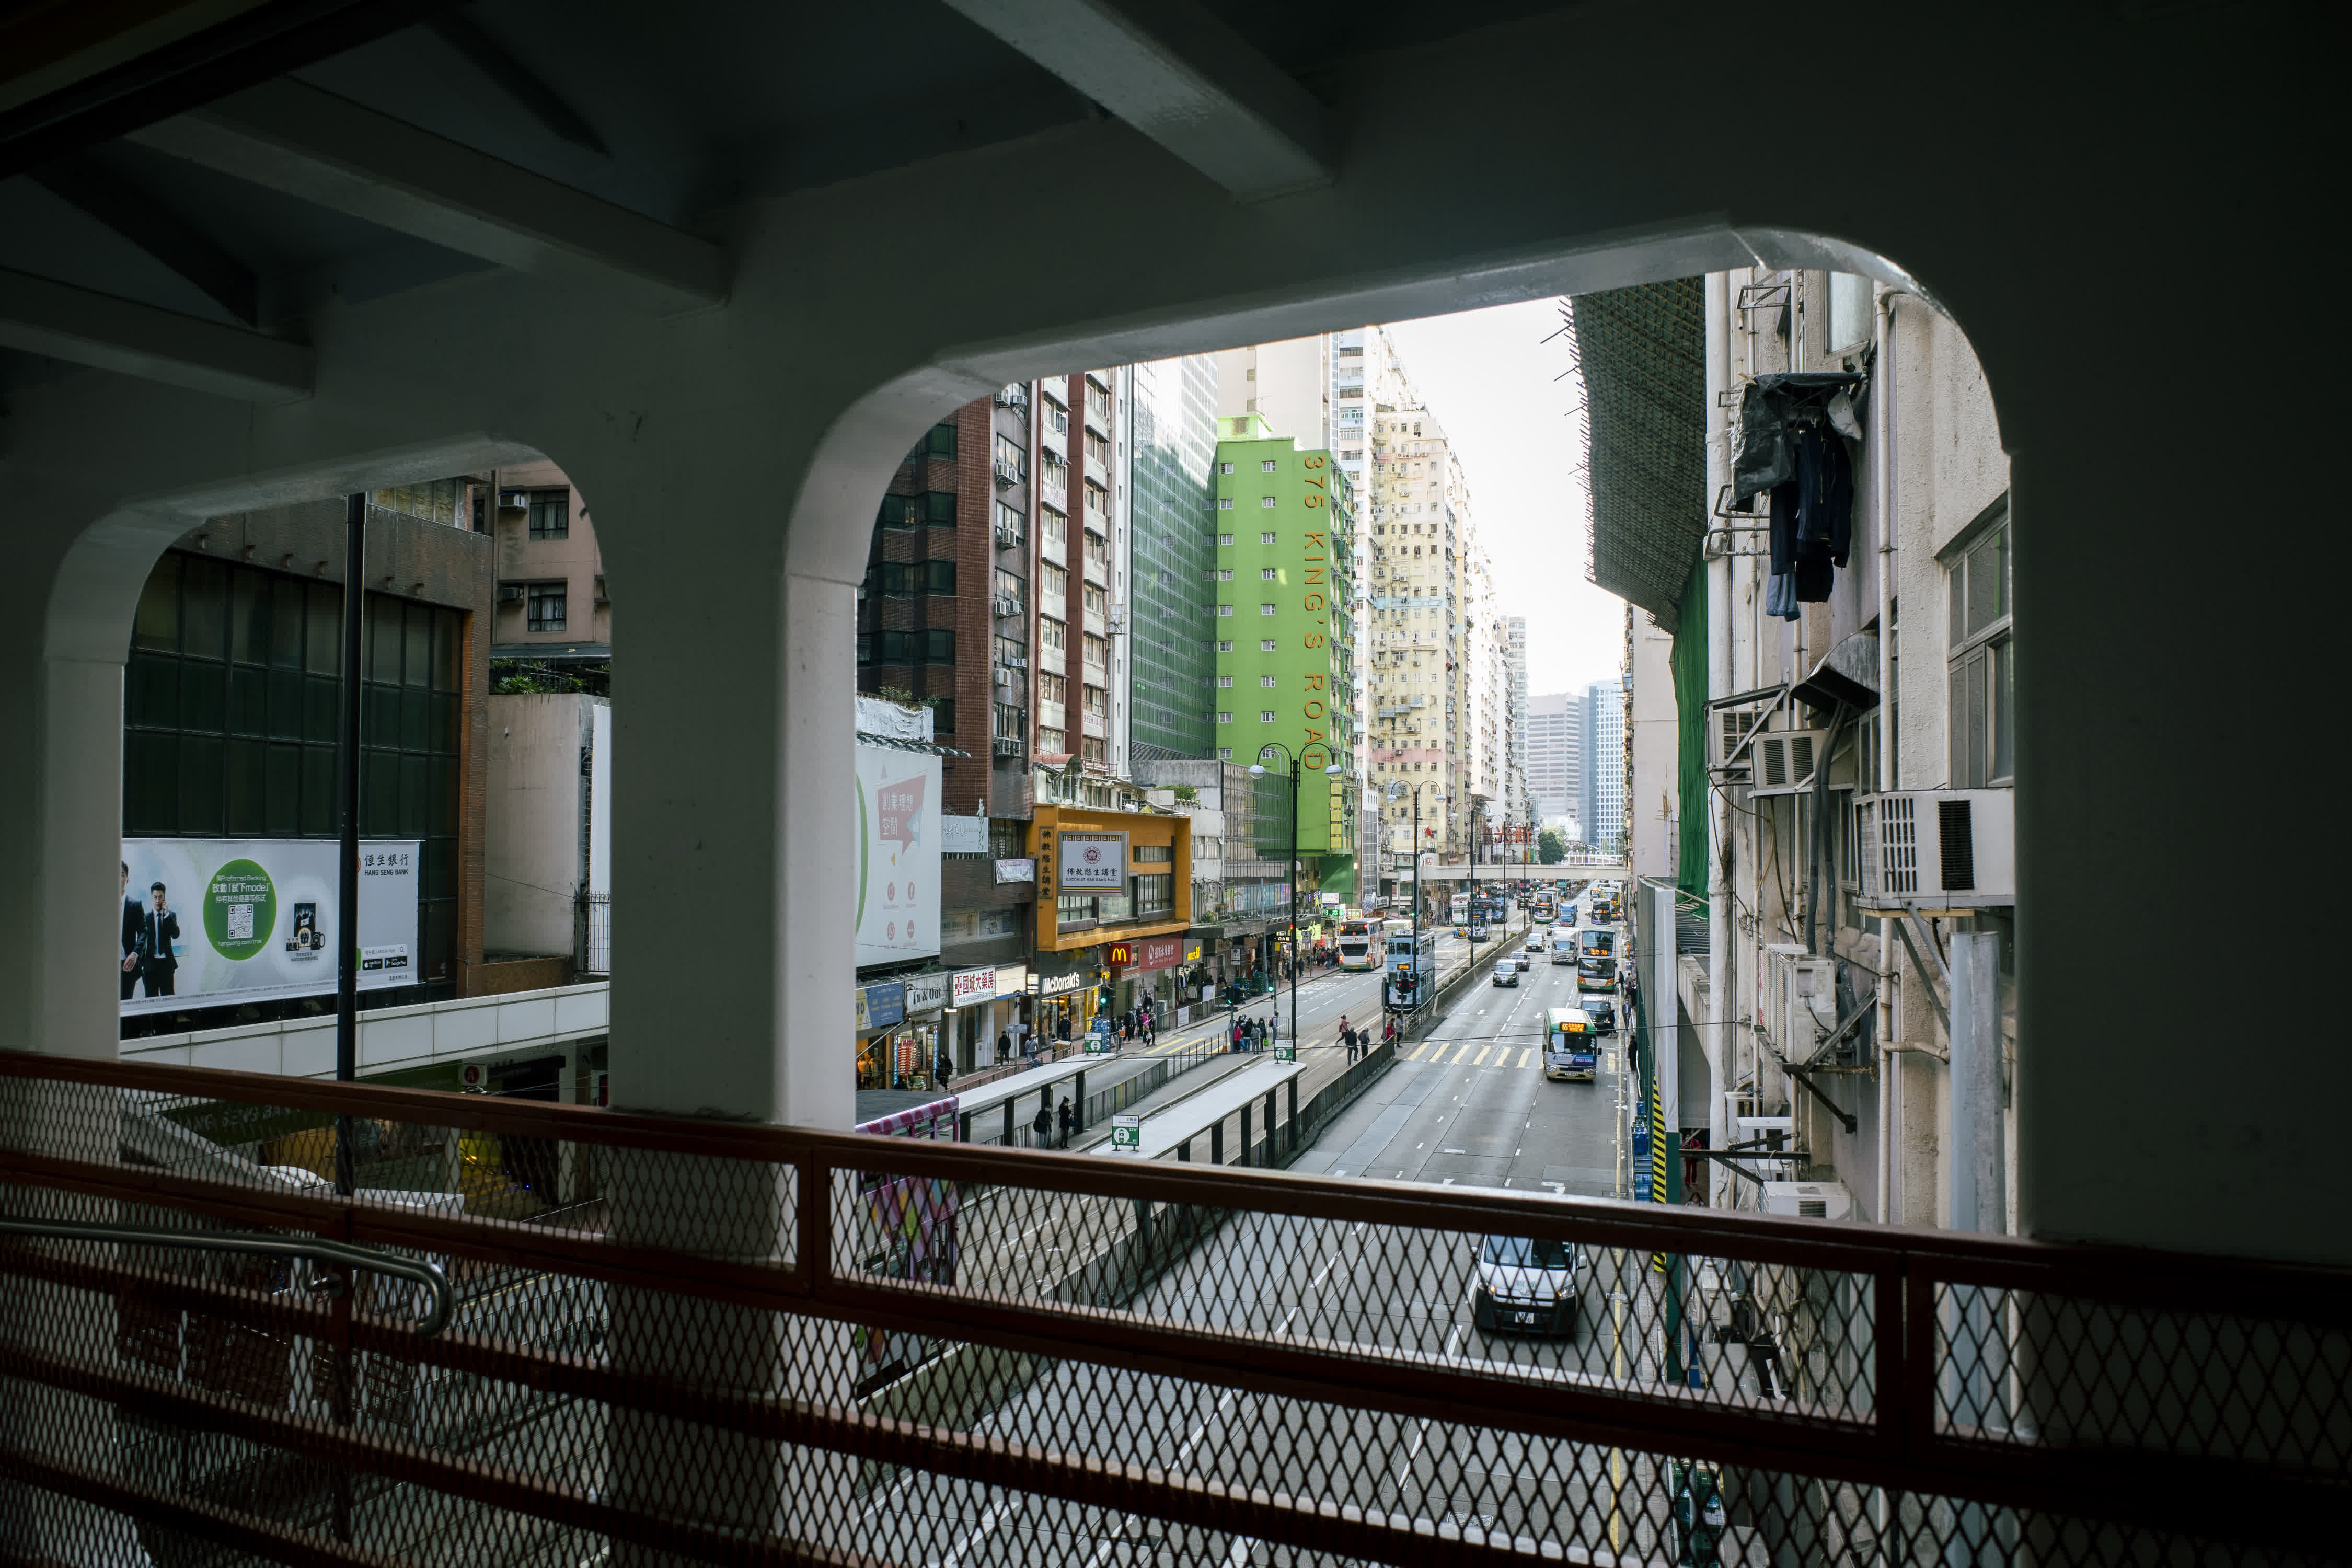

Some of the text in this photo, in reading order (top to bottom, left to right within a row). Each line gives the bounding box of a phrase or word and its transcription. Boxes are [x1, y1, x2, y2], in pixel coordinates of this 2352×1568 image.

[1304, 455, 1325, 771] 375 KING'S ROAD
[882, 816, 898, 836] 空間
[963, 970, 994, 994] 國城大藥房
[1042, 972, 1080, 995] McDonald's
[913, 991, 920, 1004] In
[922, 990, 928, 1002] &
[929, 987, 941, 1000] Out
[1562, 1023, 1569, 1031] 65
